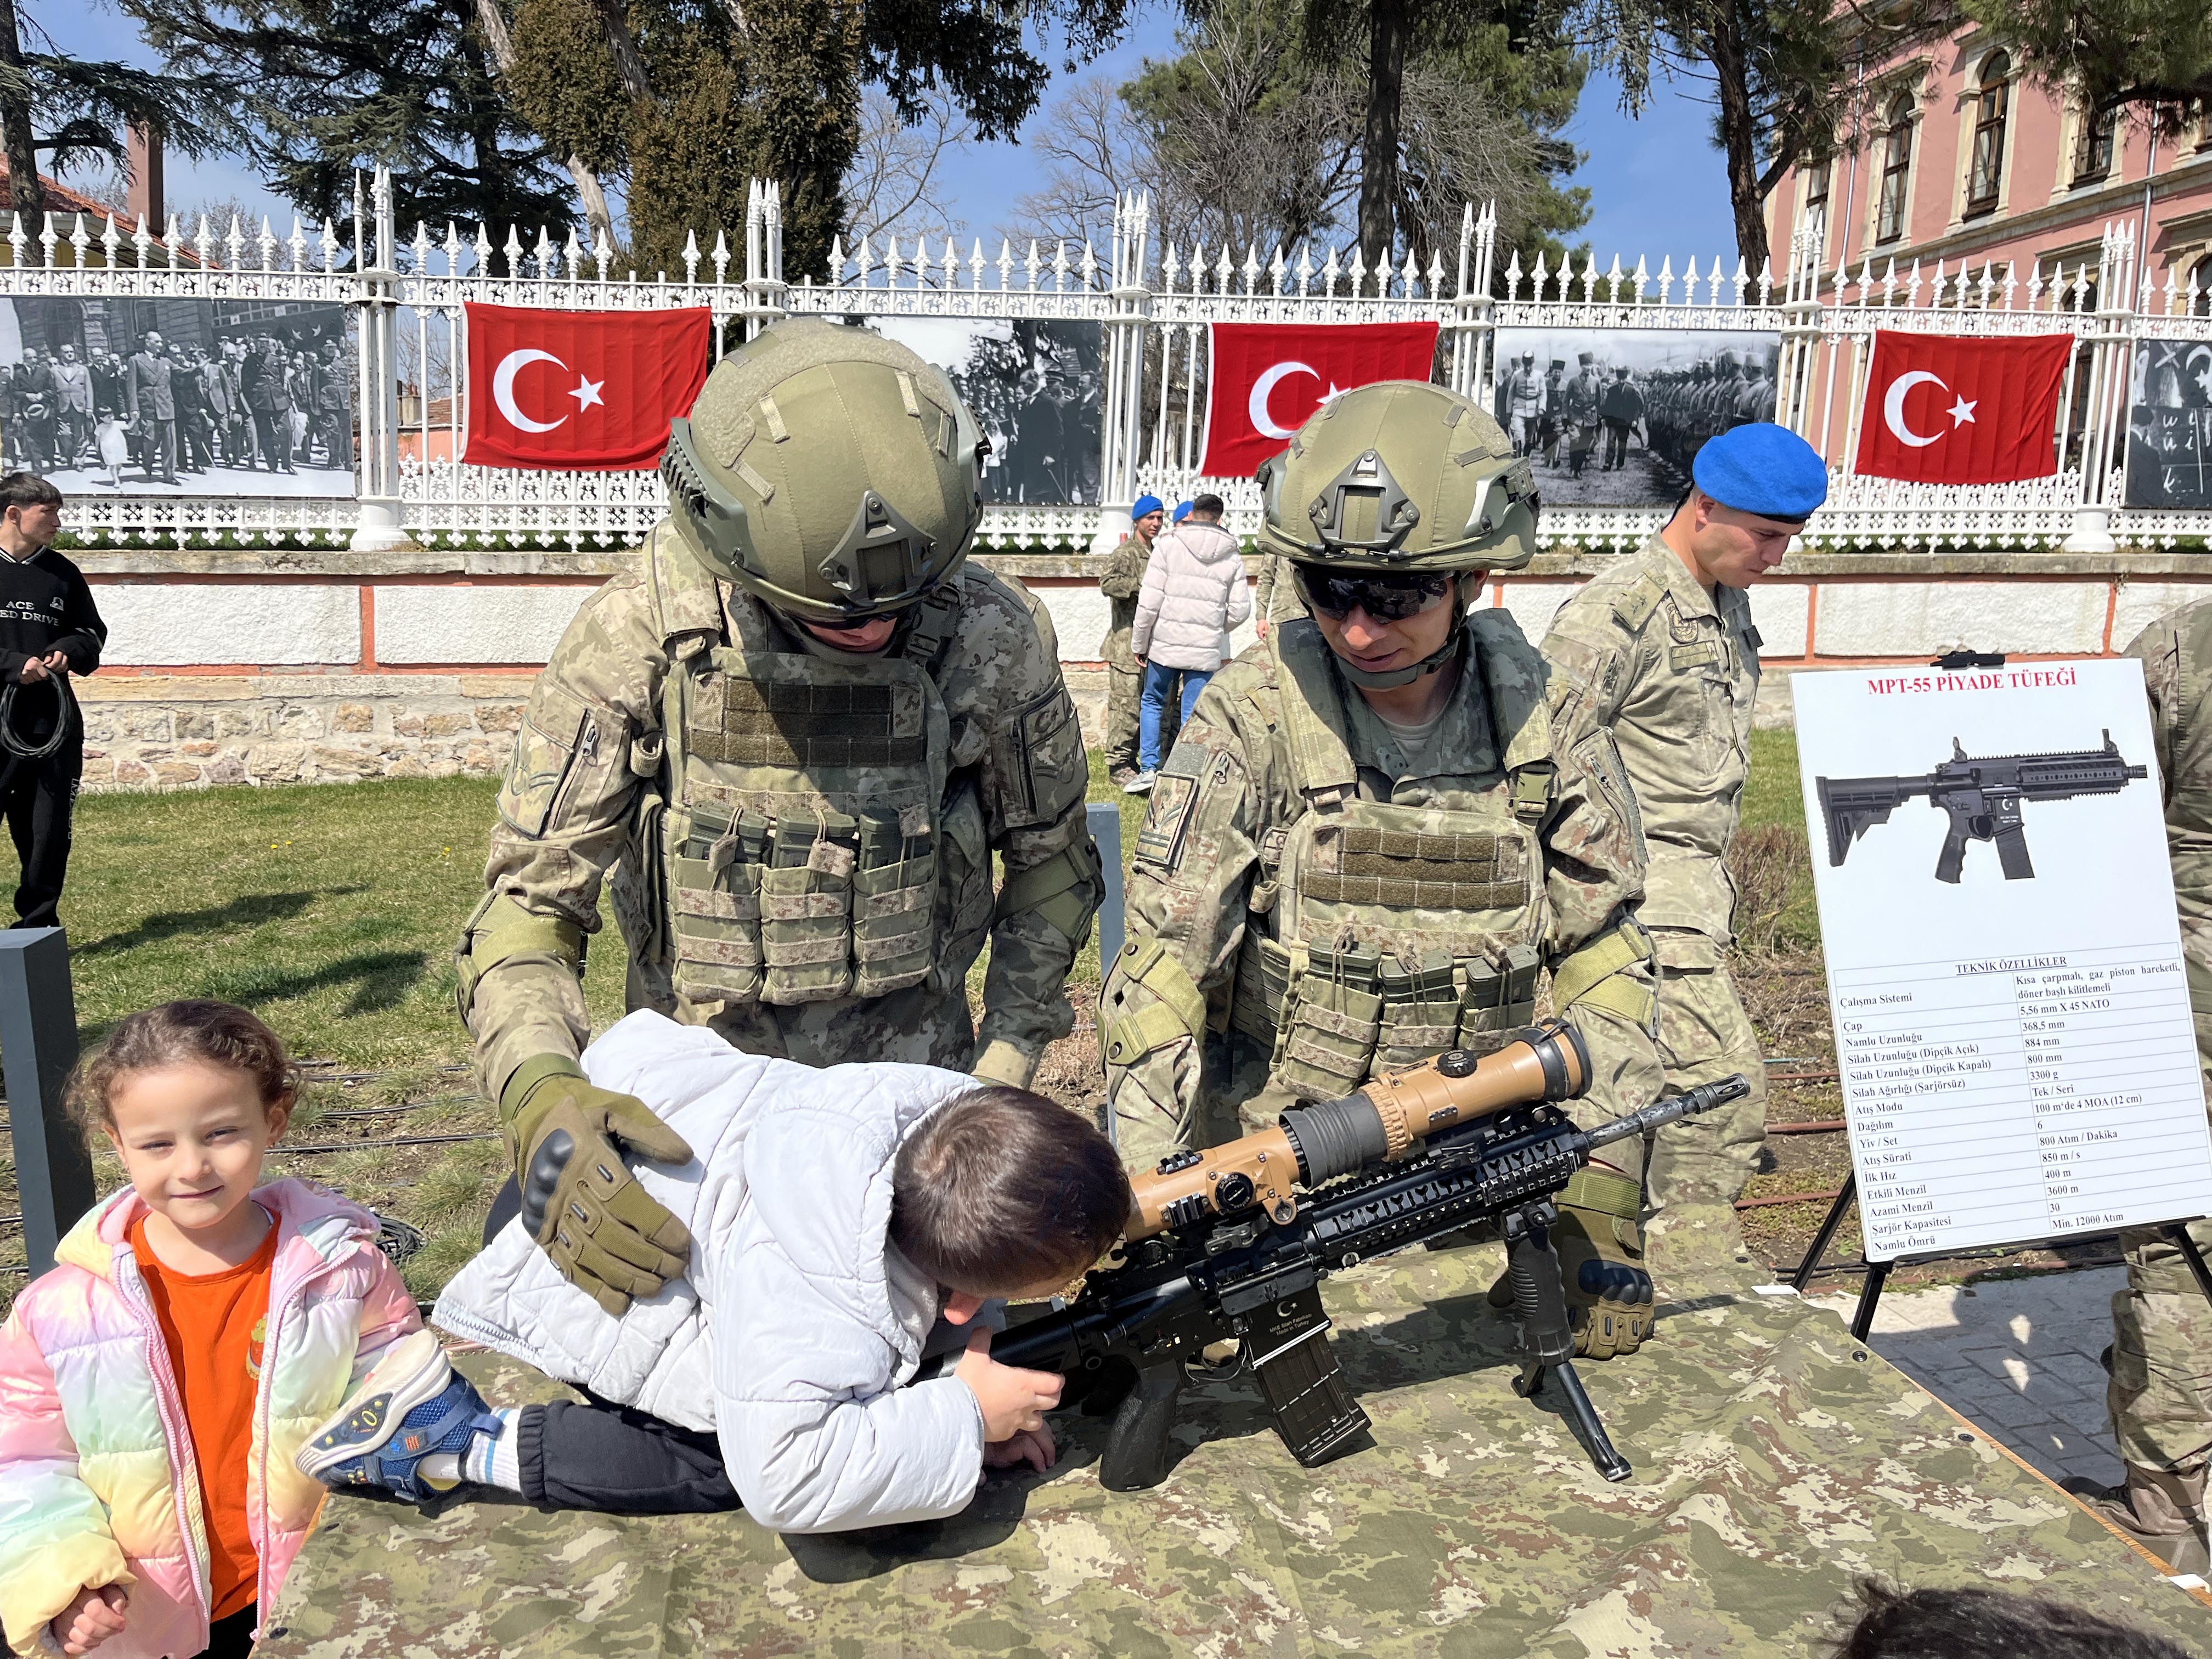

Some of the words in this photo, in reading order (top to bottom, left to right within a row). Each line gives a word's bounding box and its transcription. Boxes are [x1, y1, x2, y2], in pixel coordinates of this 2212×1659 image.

[6, 601, 35, 610] ACE
[22, 611, 59, 626] DRIVE
[1868, 677, 1931, 695] MPT-55
[1937, 673, 2004, 691] PİYADE
[2009, 667, 2077, 687] TÜFEĞİ
[1955, 960, 1997, 973] TEKNİK
[1999, 956, 2067, 969] ÖZELLİKLER
[2016, 976, 2036, 985] Kısa
[2089, 972, 2103, 981] gaz
[2109, 968, 2135, 979] piston
[2018, 988, 2044, 999] döner
[2045, 987, 2066, 997] başlı
[2068, 983, 2111, 995] kilitlemeli
[1840, 997, 1877, 1009] Çalışma
[1879, 992, 1912, 1004] Sistemi
[2059, 1003, 2068, 1012] X
[2069, 1001, 2080, 1011] 45
[2081, 999, 2109, 1009] NATO
[1843, 1022, 1862, 1032] Çap
[1846, 1035, 1876, 1047] Namlu
[1879, 1033, 1922, 1045] Uzunluğu
[2025, 1038, 2040, 1047] 884
[1848, 1054, 1871, 1064] Silah
[1874, 1051, 1917, 1062] Uzunluğu
[1920, 1046, 1953, 1059] (Dipçik
[1955, 1044, 1979, 1056] Açık)
[2027, 1054, 2043, 1064] 800
[1850, 1070, 1873, 1081] Silah
[1876, 1066, 1920, 1079] Uzunluğu
[1922, 1063, 1955, 1075] (Dipçik
[1958, 1059, 1991, 1072] Kapalı)
[2030, 1070, 2050, 1080] 3300
[2053, 1071, 2059, 1080] g
[1852, 1087, 1875, 1098] Silah
[1877, 1084, 1912, 1096] Ağırlığı
[1915, 1079, 1965, 1093] (Şarjörsüz)
[2032, 1087, 2049, 1097] Tek
[2056, 1084, 2074, 1094] Seri
[1856, 1106, 1874, 1115] Atış
[1876, 1102, 1903, 1112] Modu
[2035, 1103, 2050, 1113] 100
[2077, 1100, 2082, 1109] 4
[2084, 1098, 2109, 1107] MOA
[2111, 1095, 2124, 1105] (12
[2126, 1093, 2142, 1103] cm)
[1858, 1120, 1893, 1132] Dağılım
[2038, 1121, 2042, 1130] 6
[1859, 1139, 1874, 1148] Yiv
[1883, 1137, 1898, 1146] Set
[2040, 1136, 2055, 1146] 800
[2057, 1134, 2079, 1144] Atım
[2086, 1130, 2118, 1141] Dakika
[1862, 1156, 1881, 1166] Atış
[1883, 1152, 1911, 1163] Sürati
[2042, 1153, 2058, 1163] 850
[1865, 1170, 1878, 1182] İlk
[1880, 1171, 1895, 1181] Hız
[2045, 1169, 2060, 1179] 400
[1867, 1188, 1893, 1200] Etkili
[1895, 1184, 1926, 1196] Menzil
[2047, 1185, 2068, 1196] 3600
[1870, 1205, 1899, 1216] Azami
[1901, 1201, 1933, 1212] Menzil
[2050, 1203, 2060, 1212] 30
[1872, 1222, 1901, 1235] Şarjör
[1904, 1216, 1951, 1229] Kapasitesi
[2052, 1219, 2073, 1231] Min.
[2075, 1215, 2101, 1226] 12000
[2102, 1214, 2124, 1222] Atım
[1875, 1240, 1905, 1253] Namlu
[1908, 1235, 1936, 1247] Ömrü
